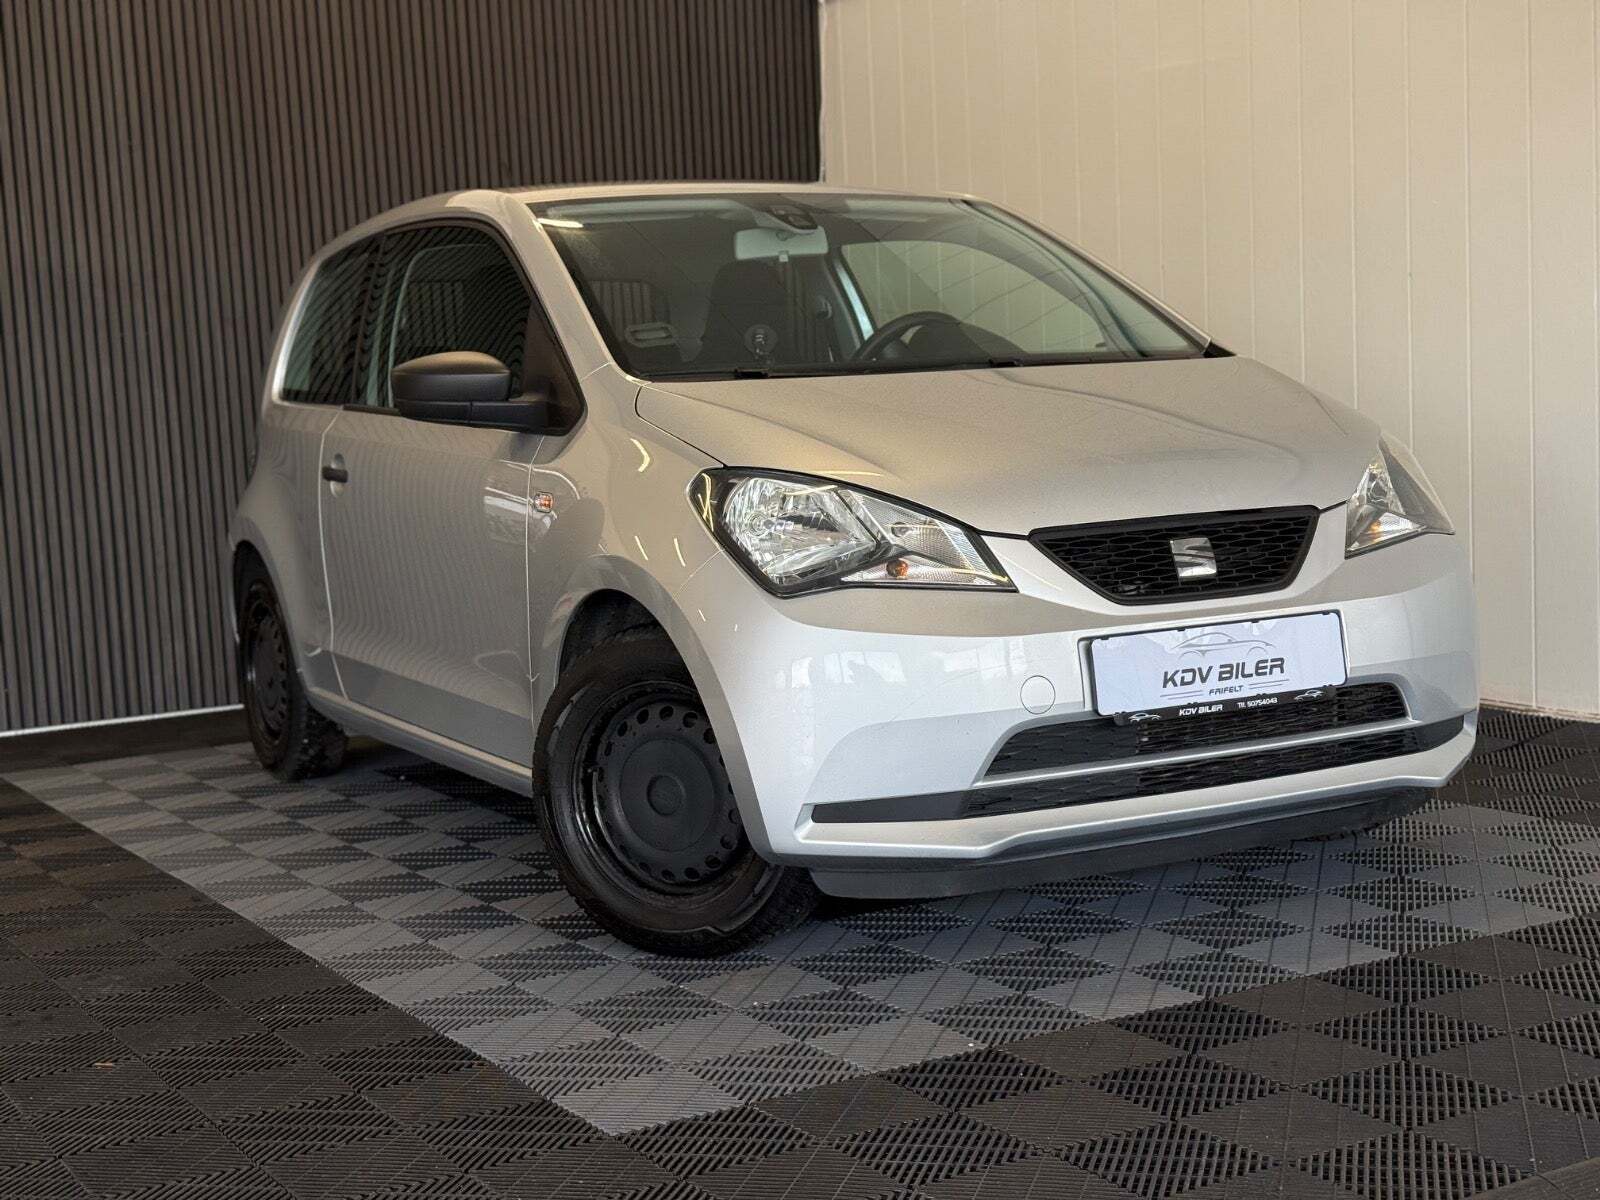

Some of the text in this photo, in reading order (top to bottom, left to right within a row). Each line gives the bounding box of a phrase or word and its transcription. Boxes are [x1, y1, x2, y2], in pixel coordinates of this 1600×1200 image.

[1162, 657, 1285, 688] KDV BILER
[1209, 685, 1244, 695] FRIFELT
[1179, 707, 1198, 716] KDV
[1198, 704, 1223, 714] BILER
